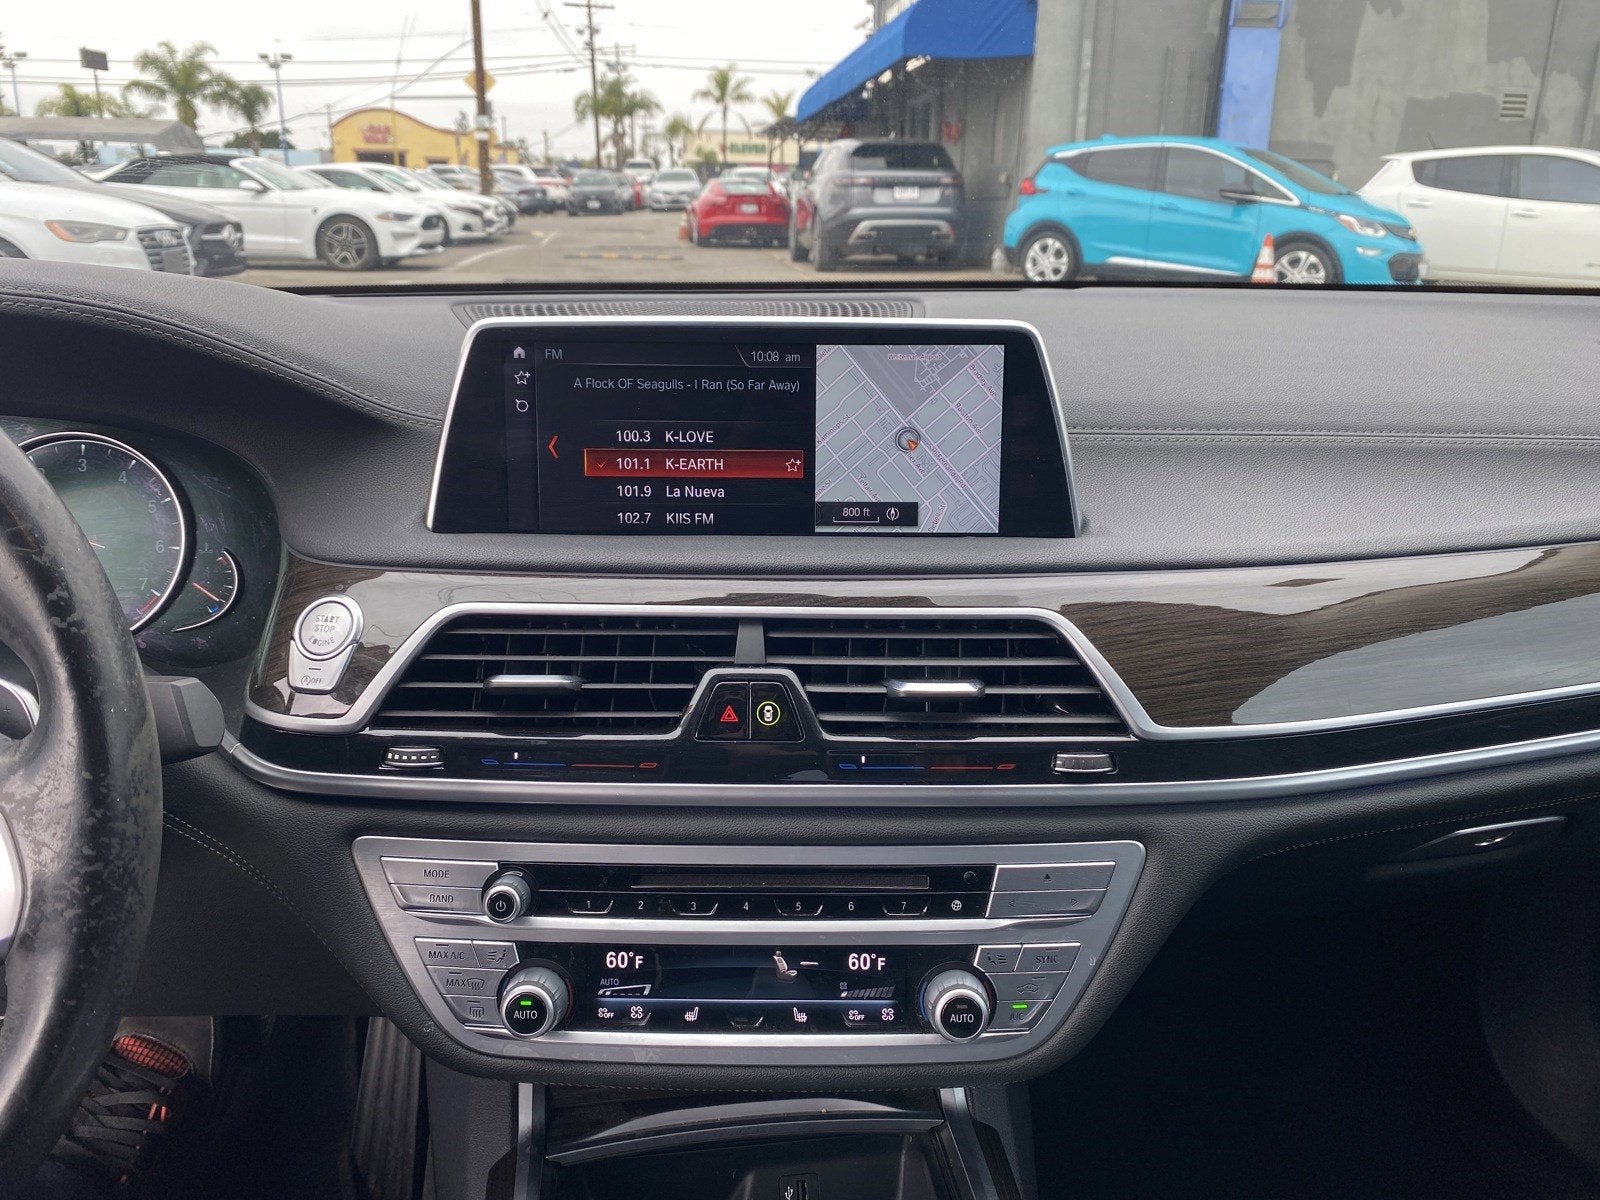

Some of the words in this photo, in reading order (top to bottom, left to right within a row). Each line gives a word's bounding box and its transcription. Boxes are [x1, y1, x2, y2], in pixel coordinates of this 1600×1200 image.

[545, 349, 563, 360] FM
[750, 351, 780, 362] 10:08
[785, 353, 801, 362] am
[573, 378, 582, 389] A
[585, 378, 615, 389] Flock
[617, 379, 633, 390] OF
[637, 379, 684, 393] Seagulls
[701, 380, 723, 390] Ran
[726, 379, 745, 392] (So
[748, 380, 766, 390] Far
[768, 379, 800, 393] Away)
[615, 430, 651, 442] 100.3
[665, 430, 714, 443] K-LOVE
[78, 459, 87, 472] 3
[616, 458, 651, 470] 101.1
[665, 458, 724, 470] K-EARTH
[118, 471, 128, 484] 4
[616, 486, 652, 497] 101.9
[666, 486, 681, 498] La
[684, 486, 725, 498] Nueva
[148, 501, 157, 514] 5
[842, 507, 861, 517] 800
[863, 507, 871, 517] ft
[617, 512, 652, 524] 102.7
[666, 513, 691, 524] KIIS
[695, 513, 714, 524] FM
[155, 540, 165, 554] 6
[139, 577, 148, 591] 7
[315, 614, 340, 624] START
[314, 624, 336, 634] STOP
[308, 635, 336, 647] ENGINE
[423, 869, 450, 879] MODE
[429, 894, 454, 903] BAND
[586, 901, 591, 909] 1
[638, 901, 644, 910] 2
[690, 902, 697, 911] 3
[742, 902, 749, 911] 4
[795, 902, 802, 911] 5
[848, 902, 855, 911] 6
[900, 902, 908, 911] 7
[428, 950, 448, 959] MAX
[450, 951, 465, 960] A/C
[606, 951, 644, 969] 60°F
[1035, 955, 1059, 965] SYNC
[848, 953, 886, 971] 60°F
[445, 978, 466, 987] MAX
[600, 978, 619, 986] AUTO
[513, 1010, 538, 1019] AUTO
[950, 1013, 974, 1023] AUTO
[1009, 1012, 1024, 1021] A/C
